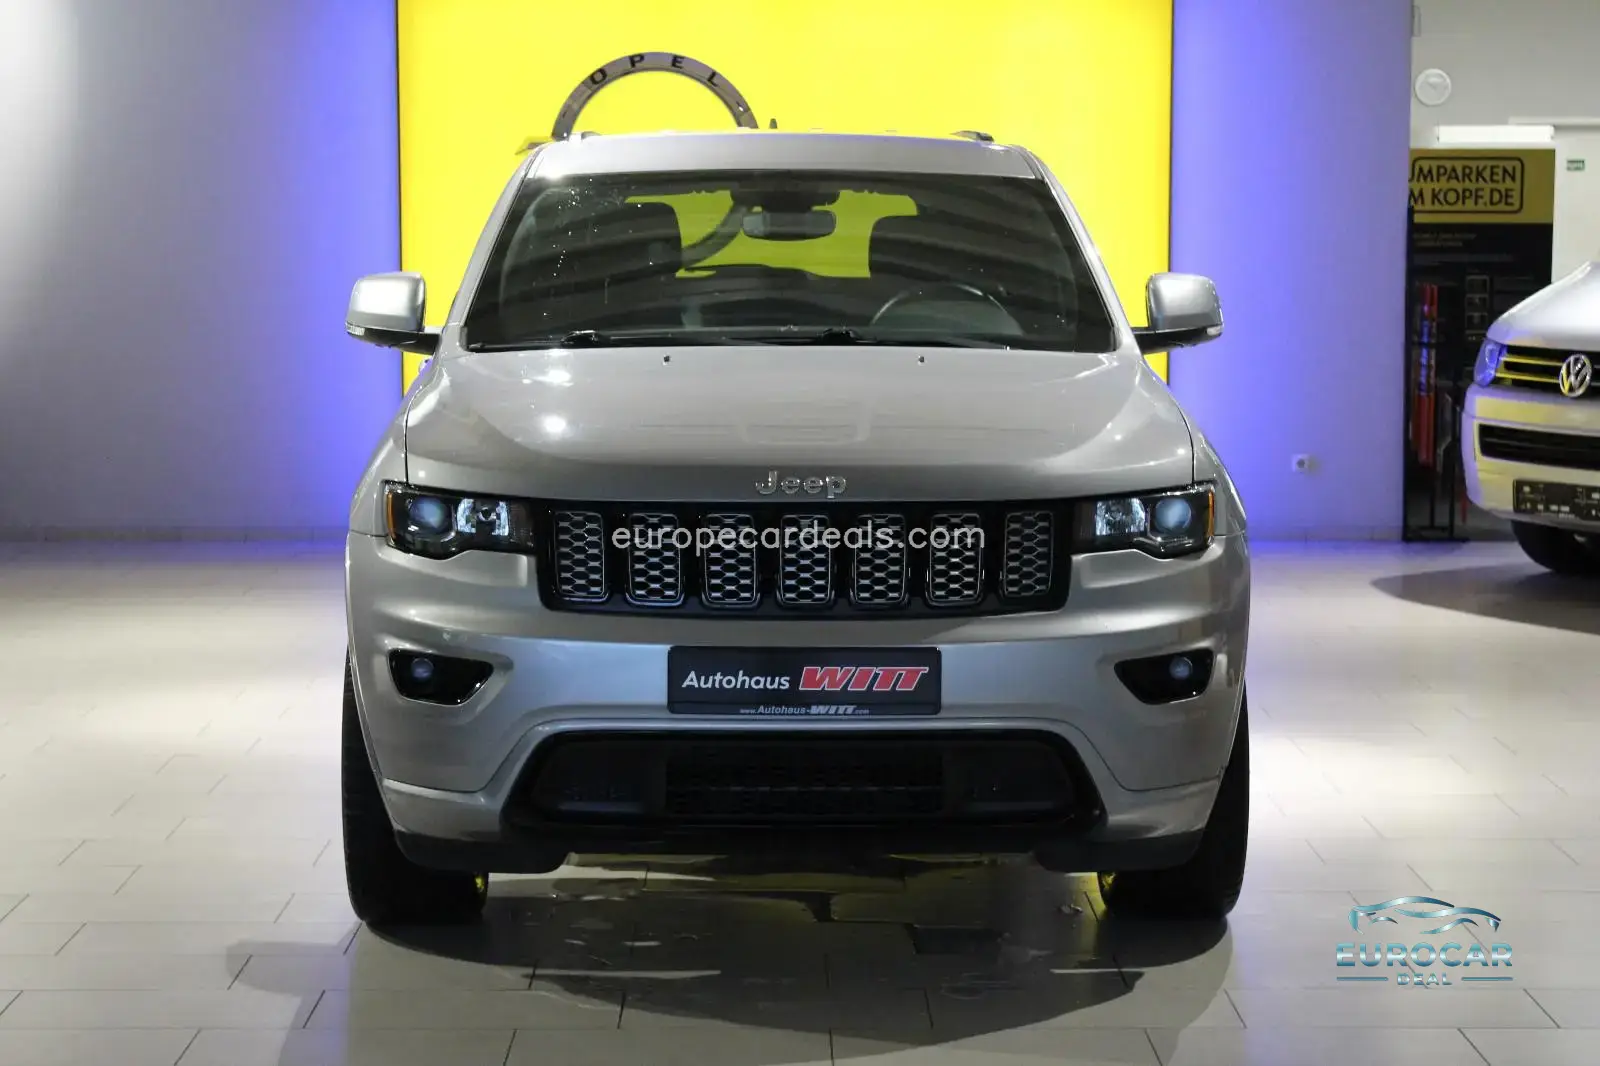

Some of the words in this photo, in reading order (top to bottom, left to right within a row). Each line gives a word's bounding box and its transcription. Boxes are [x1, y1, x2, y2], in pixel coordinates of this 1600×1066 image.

[590, 54, 719, 87] OPEL
[1431, 188, 1515, 207] KOPF.DE
[755, 470, 848, 499] Jeep
[681, 670, 791, 690] Autohaus
[798, 666, 930, 691] WITT
